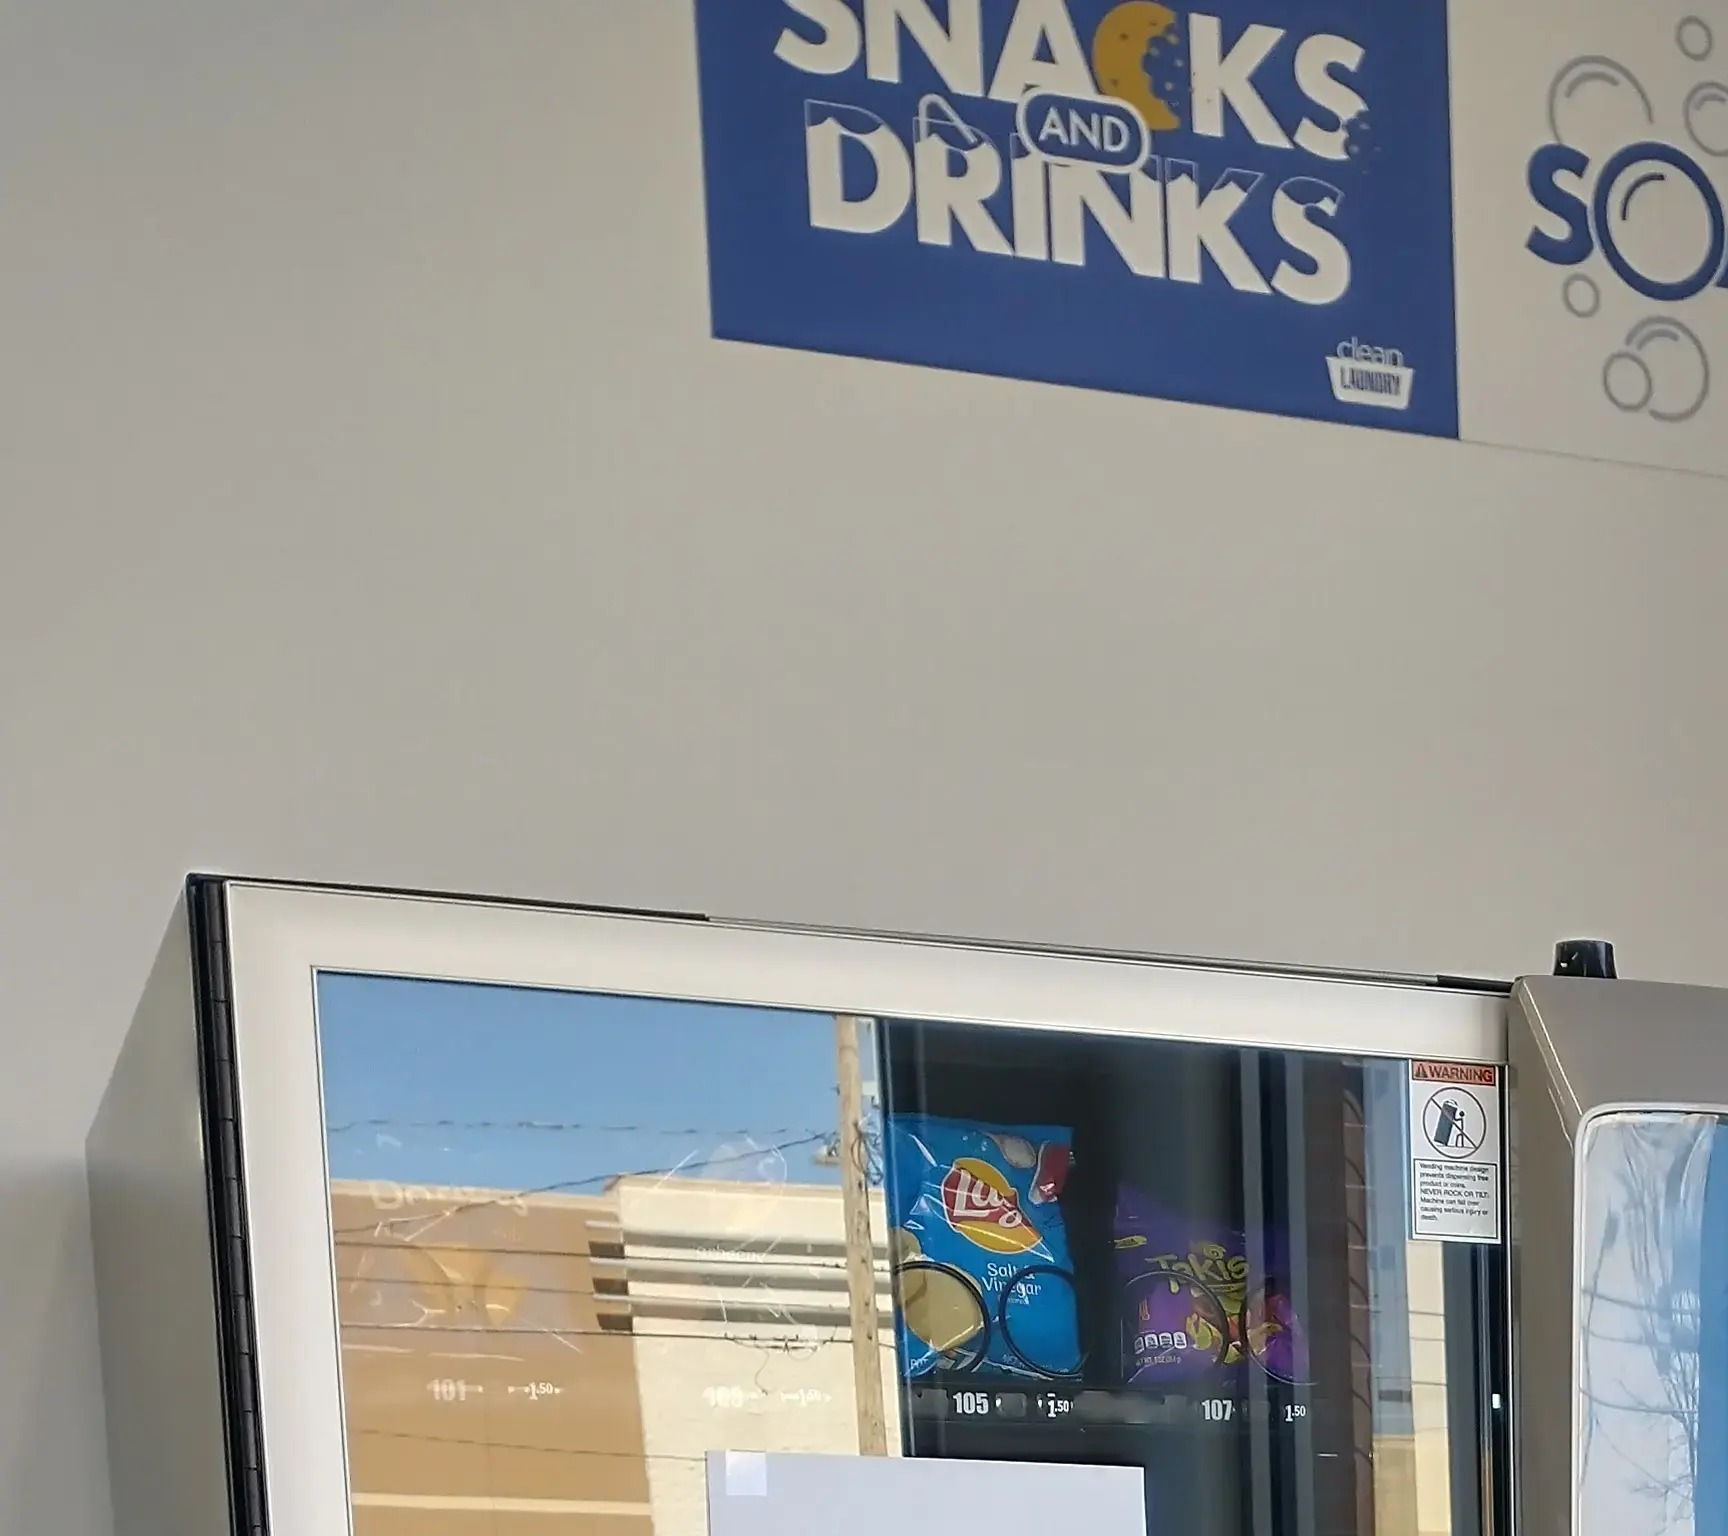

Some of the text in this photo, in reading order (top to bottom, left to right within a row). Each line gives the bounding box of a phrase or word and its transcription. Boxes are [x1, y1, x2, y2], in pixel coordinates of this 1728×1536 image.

[1039, 108, 1127, 155] AND
[804, 104, 1352, 305] DRINKS
[1337, 336, 1403, 367] clean
[1429, 1065, 1493, 1083] WARNING
[1444, 1189, 1463, 1197] ROCK
[1145, 1243, 1249, 1295] Takis
[953, 1391, 1070, 1418] 105 1.50
[1201, 1399, 1307, 1422] 107 1.50
